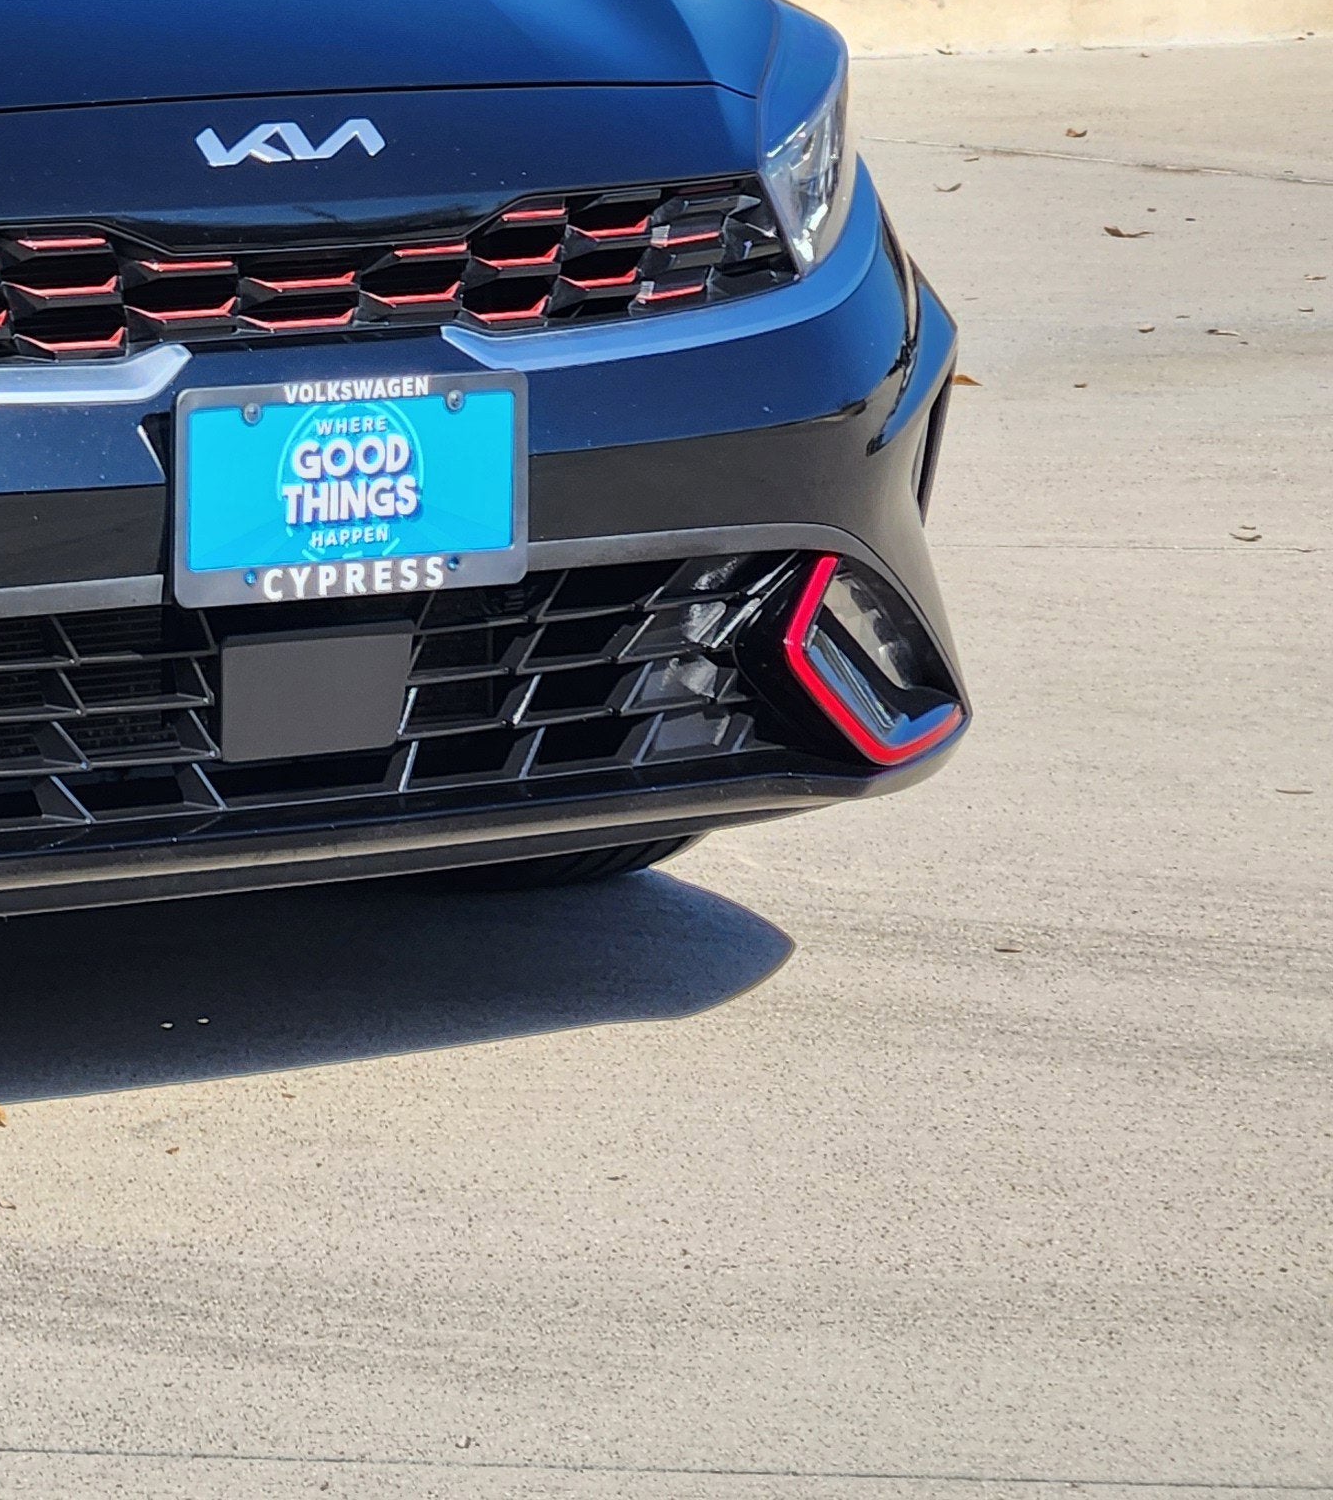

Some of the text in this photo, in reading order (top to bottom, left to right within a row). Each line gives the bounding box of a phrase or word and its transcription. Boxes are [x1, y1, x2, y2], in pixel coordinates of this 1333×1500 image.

[195, 118, 386, 168] KIA
[283, 375, 429, 404] VOLKSWAGEN
[315, 415, 389, 436] WHERE
[292, 434, 410, 480] GOOD
[283, 475, 418, 525] THINGS
[310, 524, 390, 549] HAPPEN
[263, 556, 445, 601] CYPRESS
